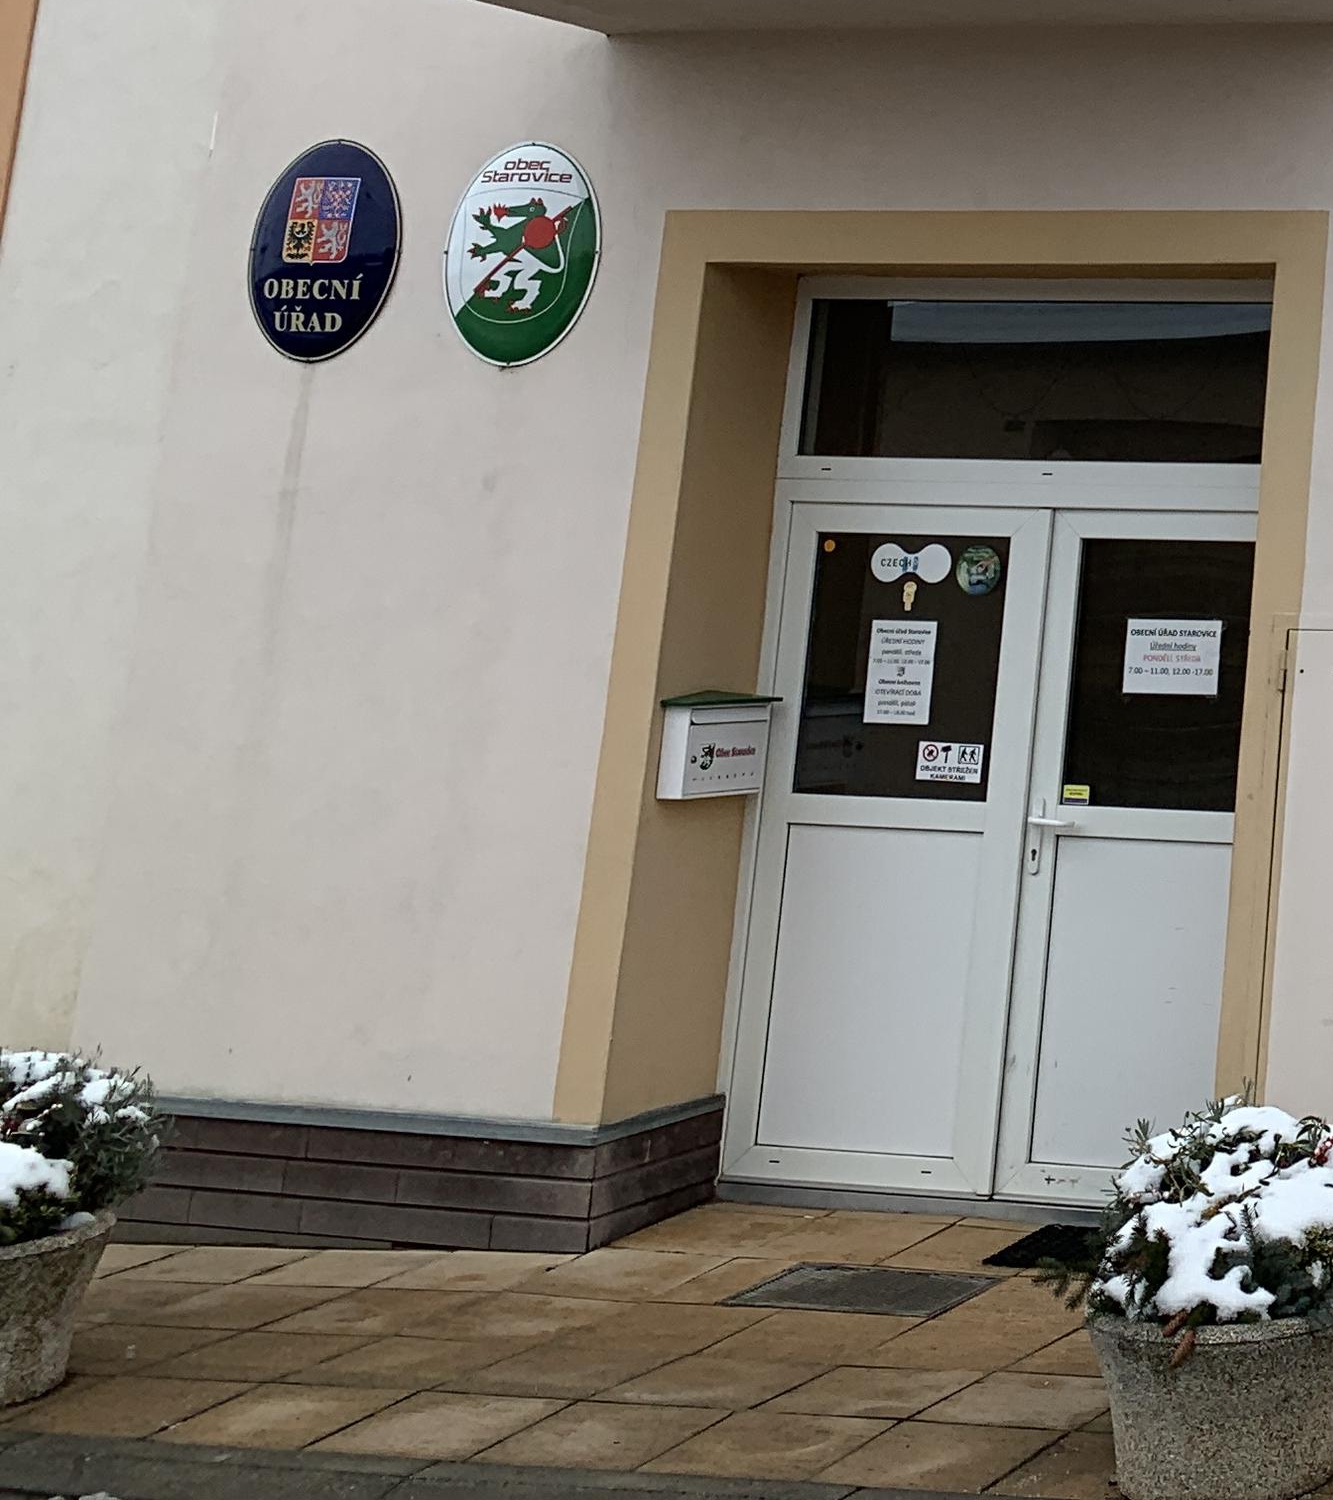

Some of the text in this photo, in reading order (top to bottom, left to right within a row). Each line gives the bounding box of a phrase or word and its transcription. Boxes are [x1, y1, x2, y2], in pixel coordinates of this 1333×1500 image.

[504, 158, 551, 172] obec
[481, 170, 572, 185] Starovice
[263, 273, 363, 300] OBECNÍ
[273, 305, 342, 333] ÚŘAD
[1131, 628, 1217, 638] OBECNÍ ÚŘAD STAROVICE
[1174, 642, 1197, 651] hodiny
